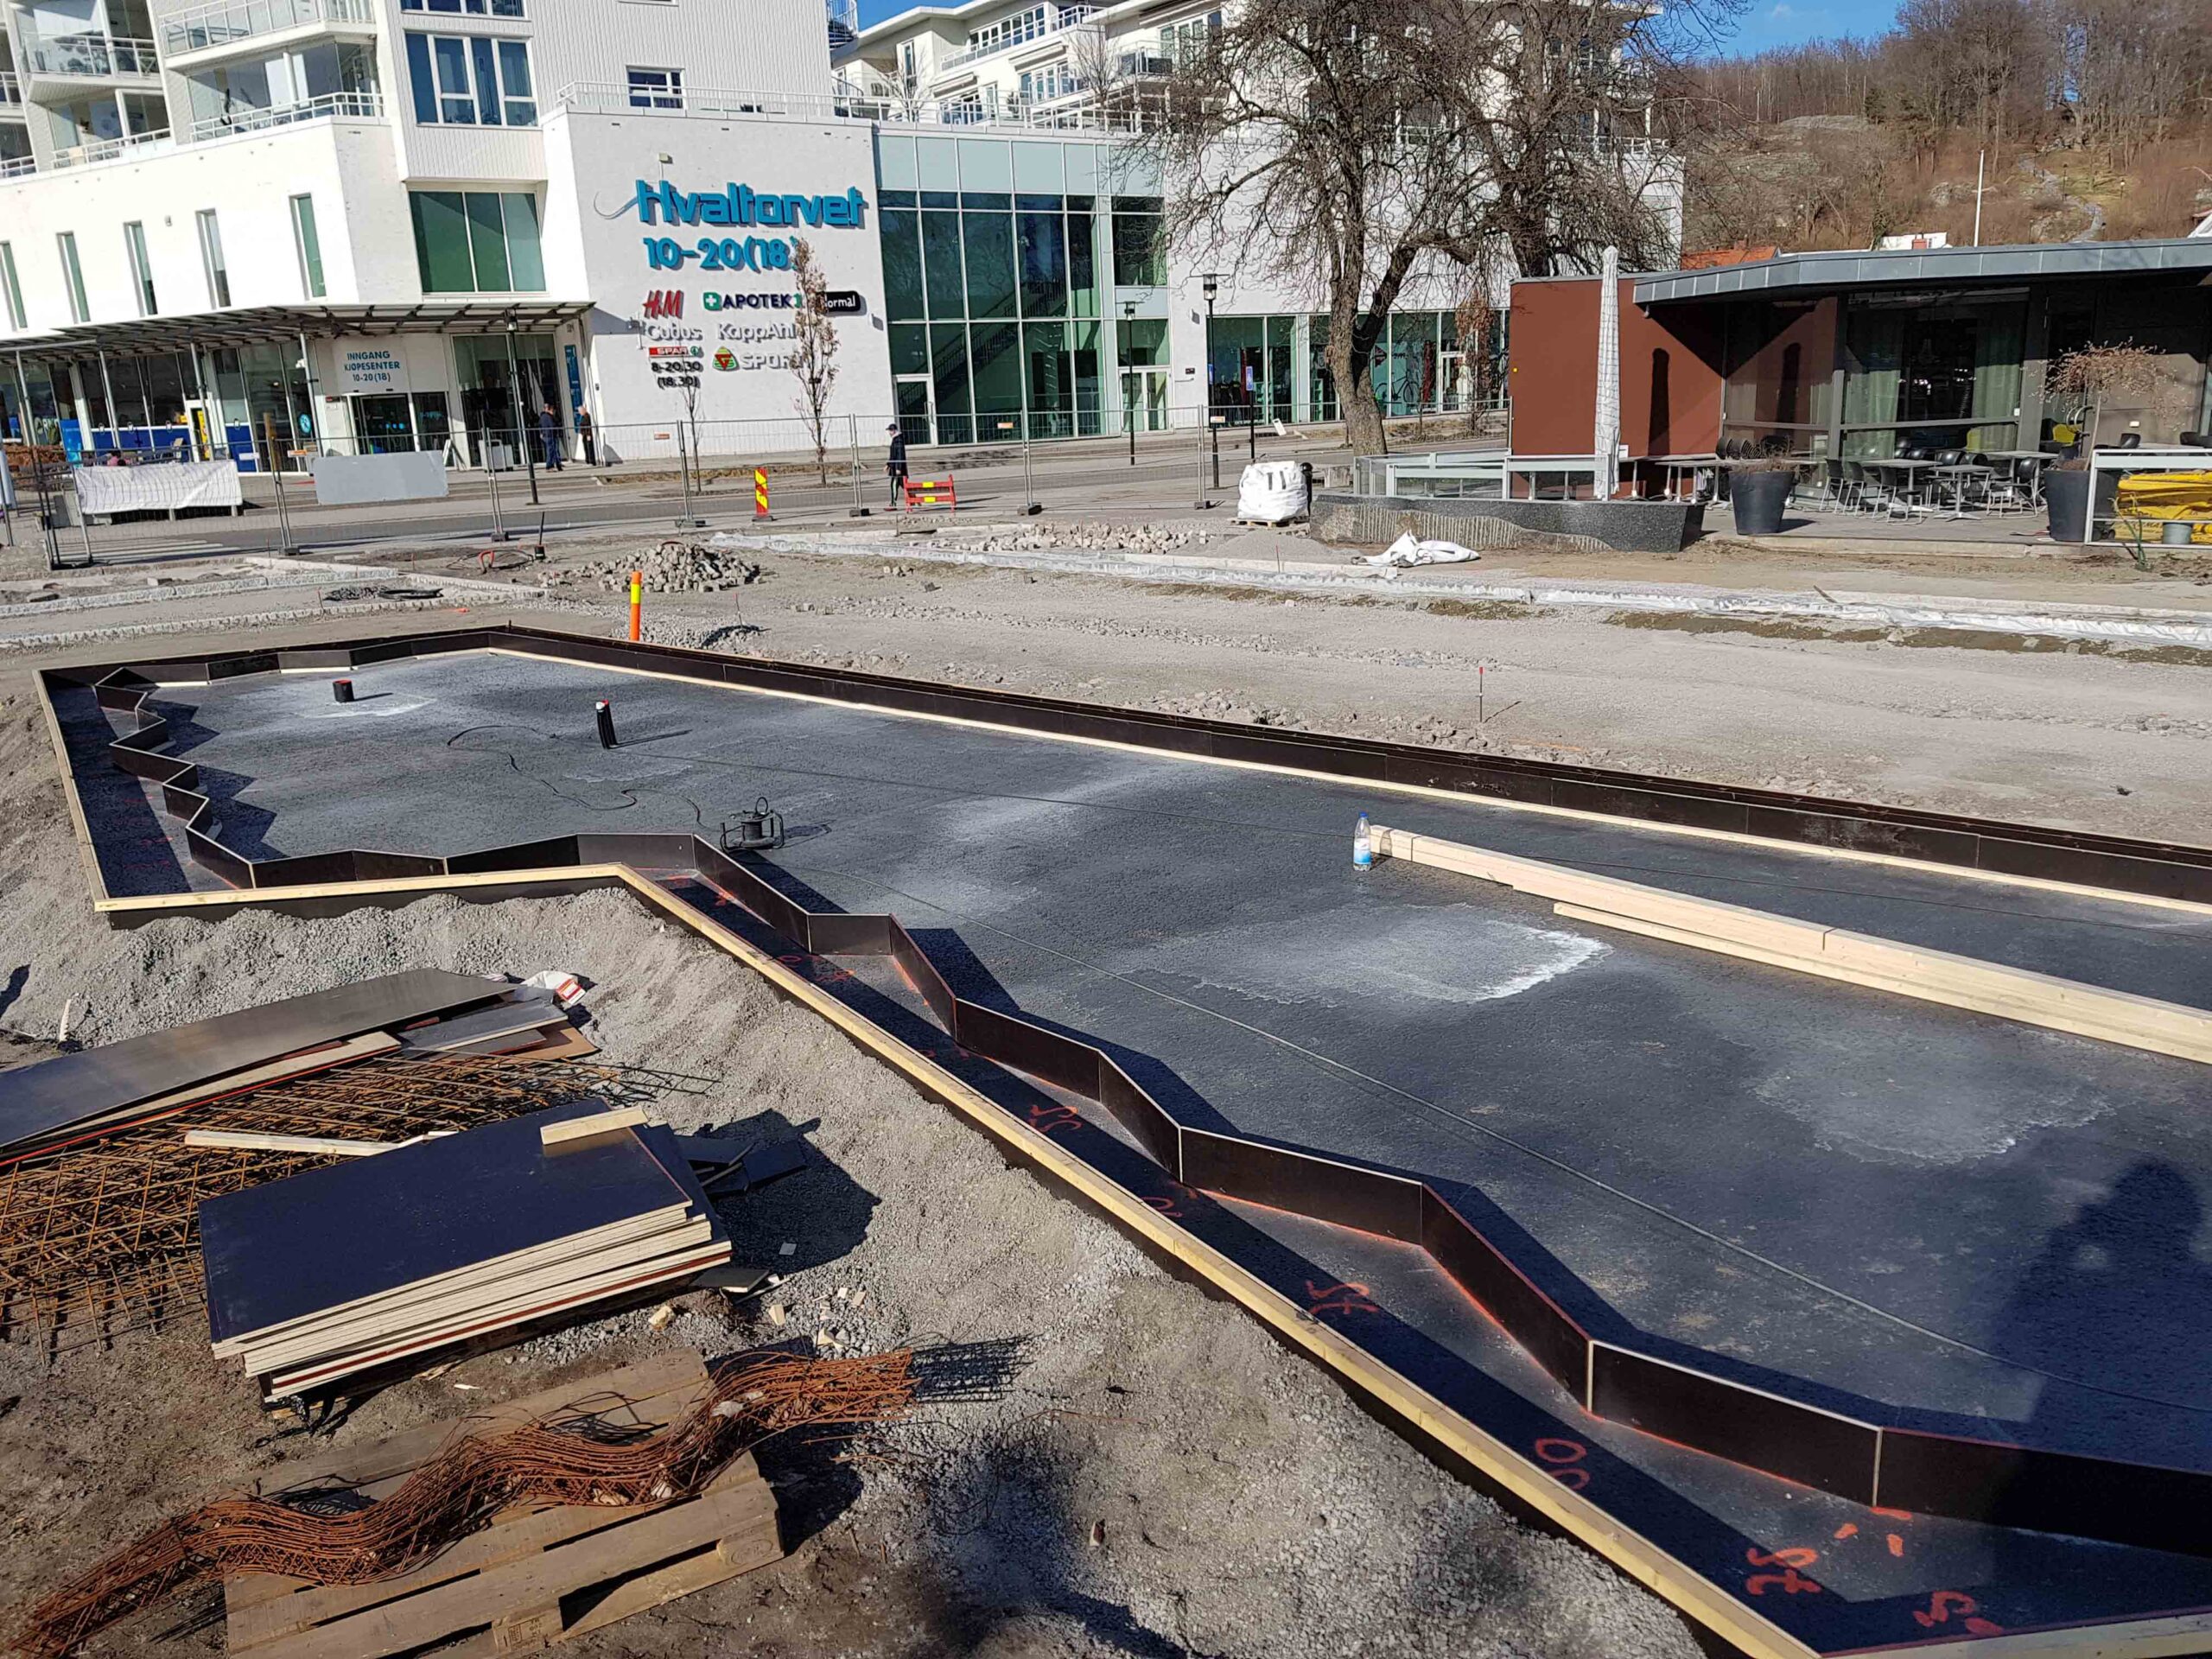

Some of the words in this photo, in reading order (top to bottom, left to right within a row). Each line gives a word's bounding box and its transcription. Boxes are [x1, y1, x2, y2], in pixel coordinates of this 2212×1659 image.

[635, 179, 867, 228] Hvaltorvet
[722, 293, 793, 309] APOTEK
[823, 296, 856, 308] ormal
[346, 350, 391, 361] INNGANG
